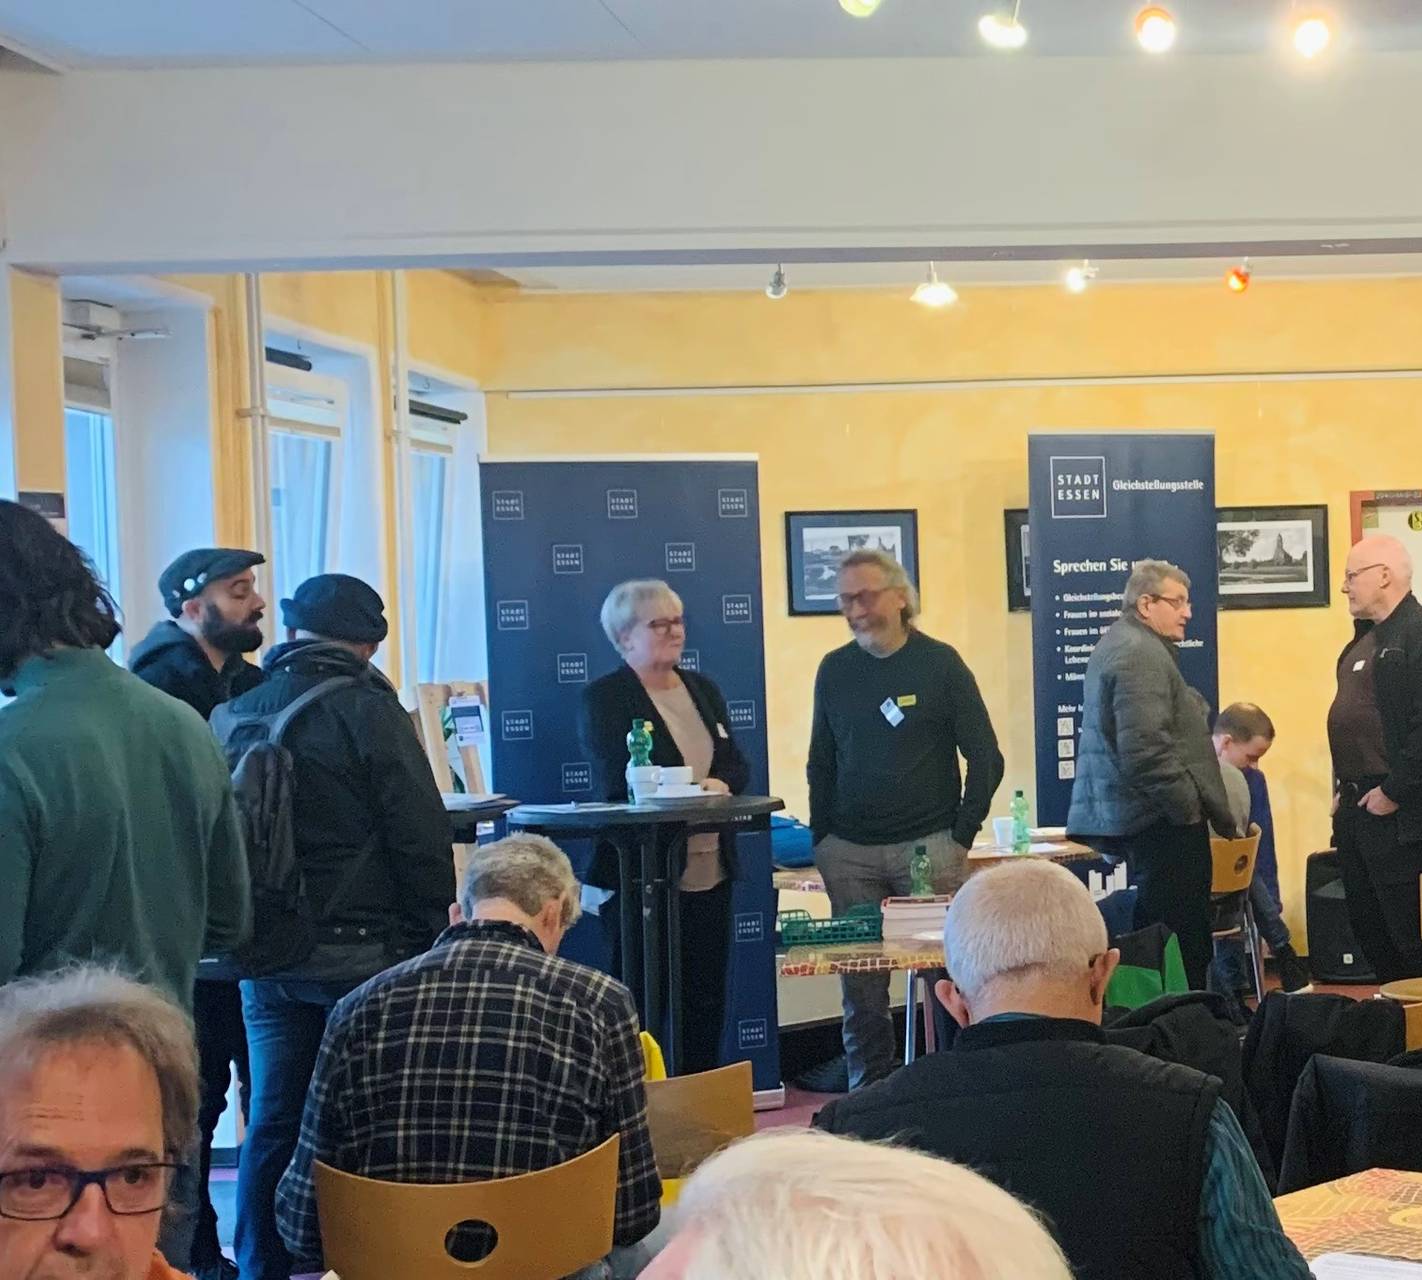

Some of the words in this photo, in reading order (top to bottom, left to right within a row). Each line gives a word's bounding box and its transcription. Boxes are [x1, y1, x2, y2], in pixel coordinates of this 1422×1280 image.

[1058, 474, 1099, 486] STADT
[1112, 480, 1204, 492] Gleichstellungsstelle
[1058, 489, 1100, 500] ESSEN
[1053, 560, 1106, 575] Sprechen
[1110, 558, 1128, 572] Sie
[1064, 610, 1088, 618] Frauen
[1064, 627, 1088, 636] Frauen
[1058, 704, 1076, 712] Mehr
